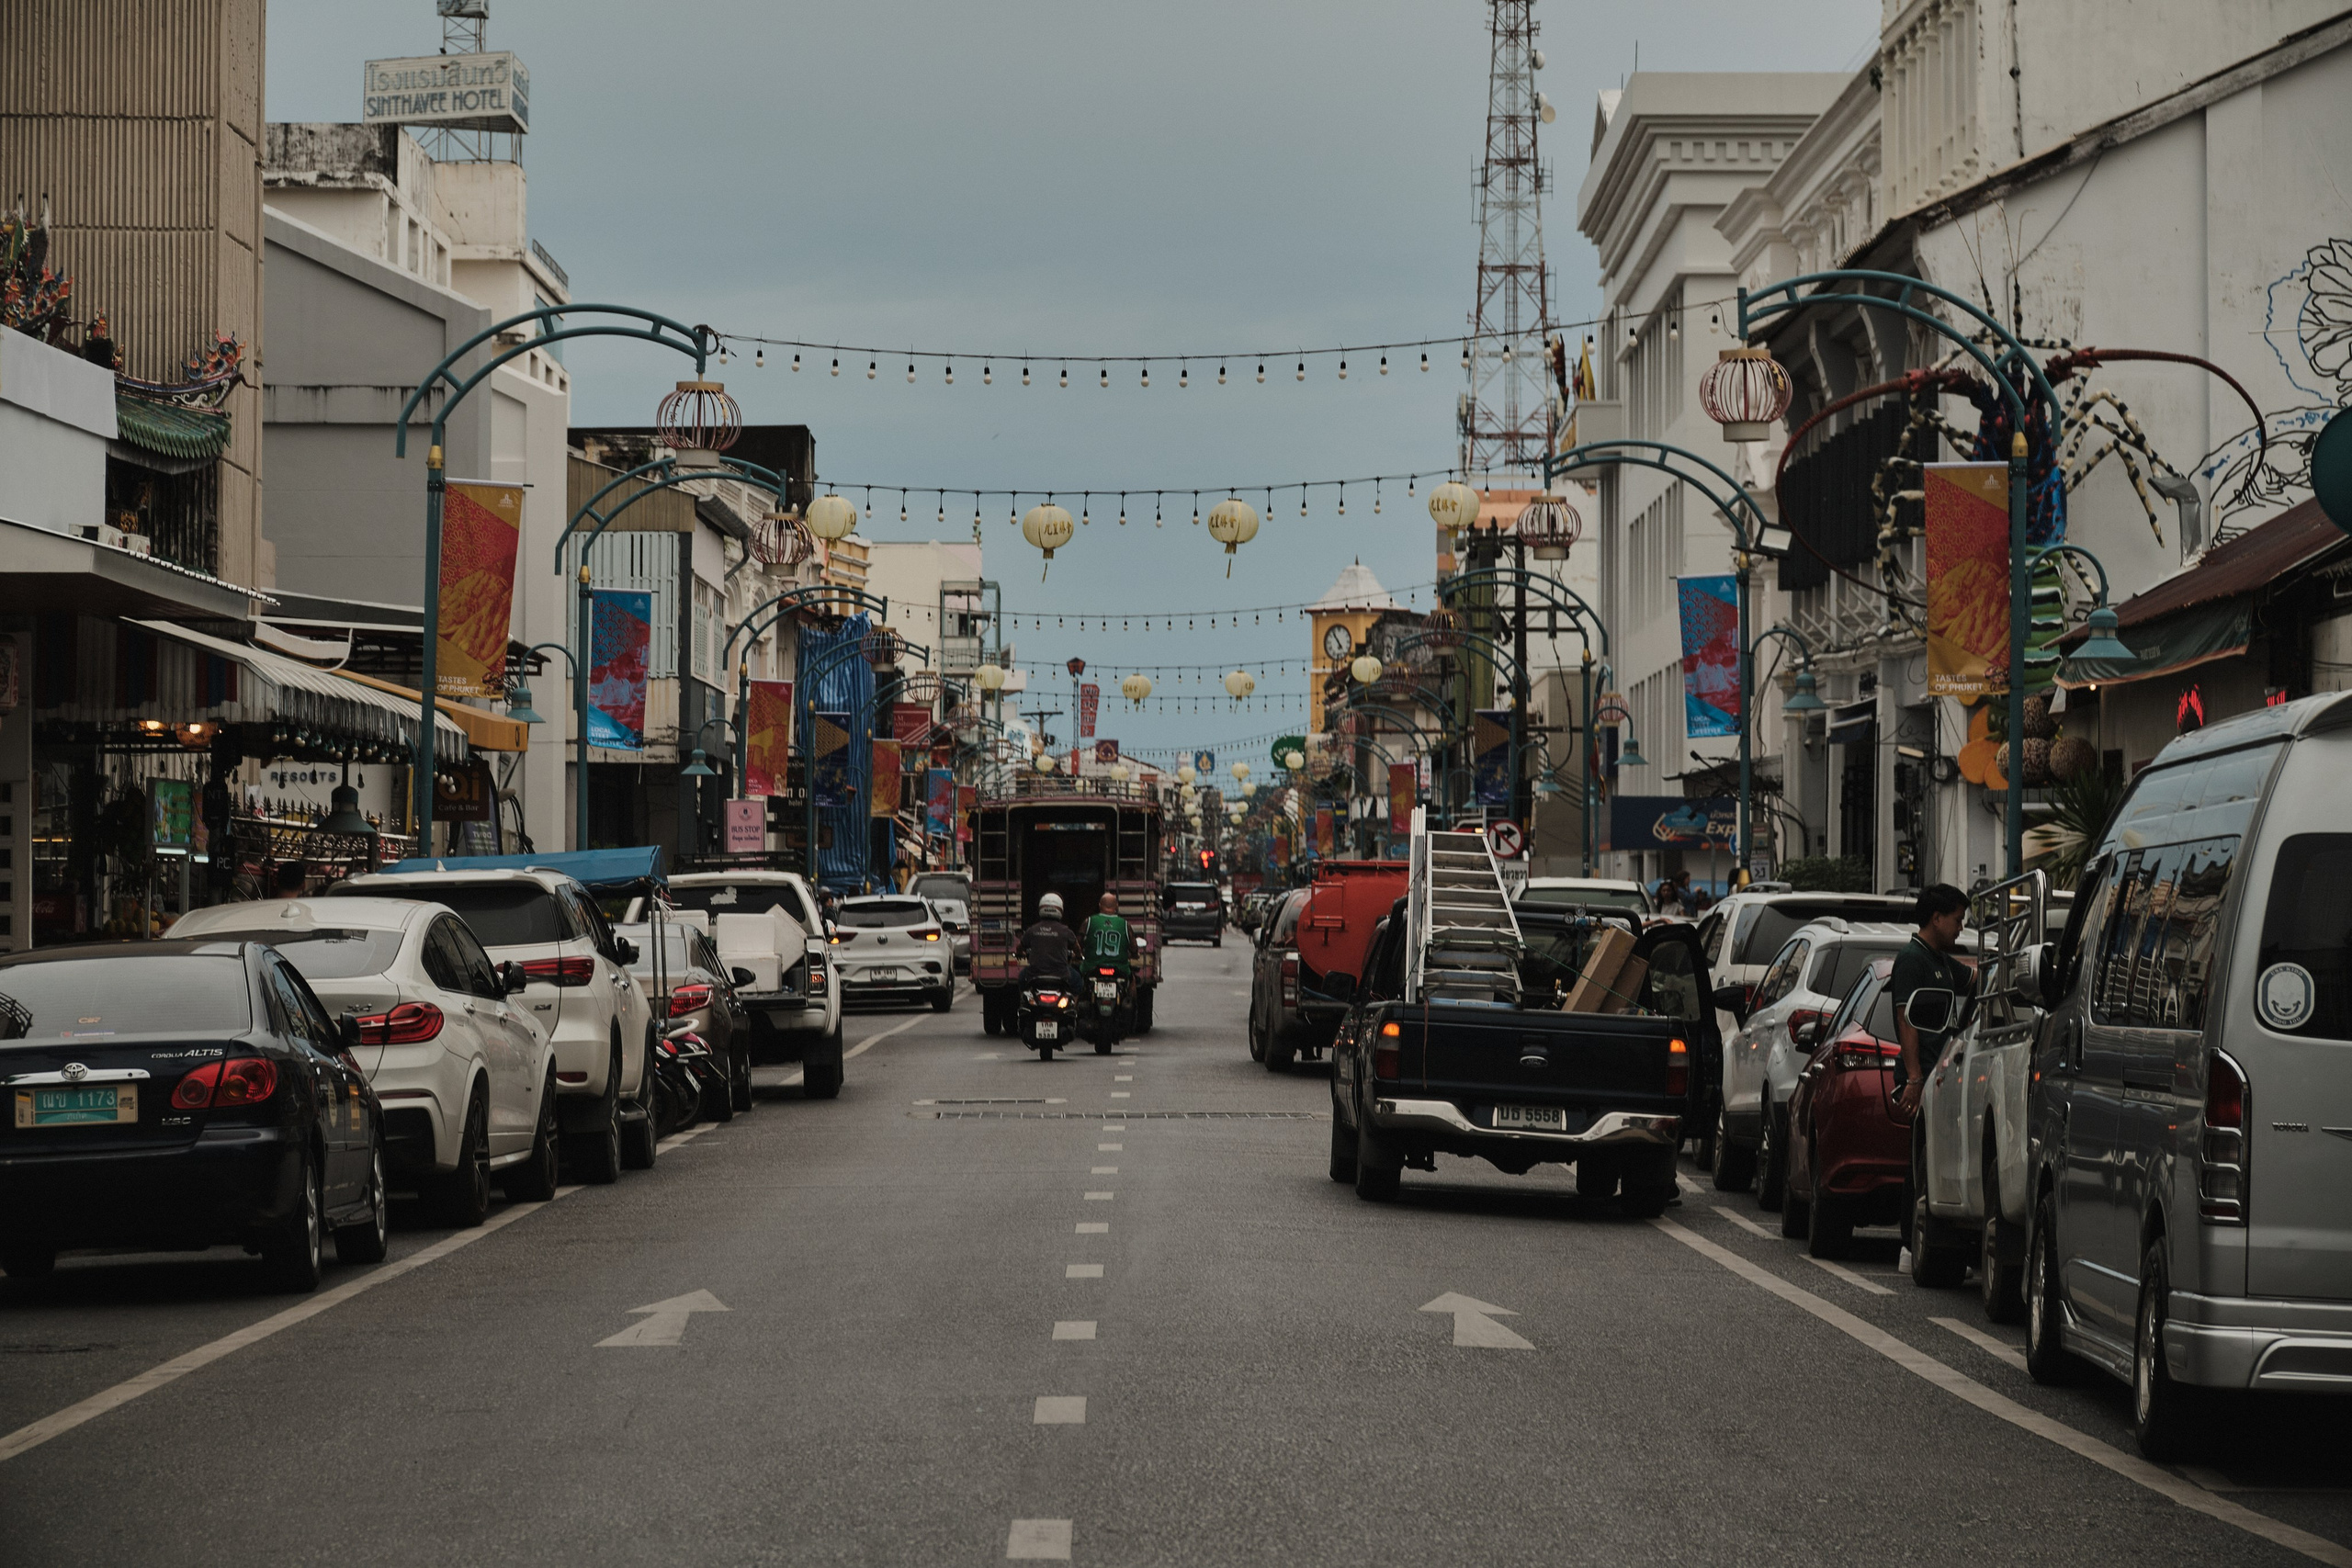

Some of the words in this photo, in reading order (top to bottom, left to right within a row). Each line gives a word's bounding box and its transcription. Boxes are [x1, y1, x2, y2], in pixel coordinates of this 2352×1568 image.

[368, 92, 447, 117] SINTHAVEE
[453, 89, 504, 111] HOTEL
[438, 676, 467, 684] TASTES
[1935, 674, 1967, 682] TASTES
[448, 685, 480, 694] PHUKET
[1935, 683, 1946, 692] OF
[1949, 682, 1984, 692] PHUKET
[591, 726, 611, 734] LOCAL
[438, 804, 457, 812] Cafe
[1705, 821, 1736, 838] Exp
[1094, 930, 1122, 957] 19
[185, 1049, 223, 1057] ALTIS
[77, 1090, 116, 1108] 1173
[1525, 1108, 1560, 1122] 5558
[162, 1117, 191, 1125] VSC
[2272, 1122, 2309, 1132] TOYOTA
